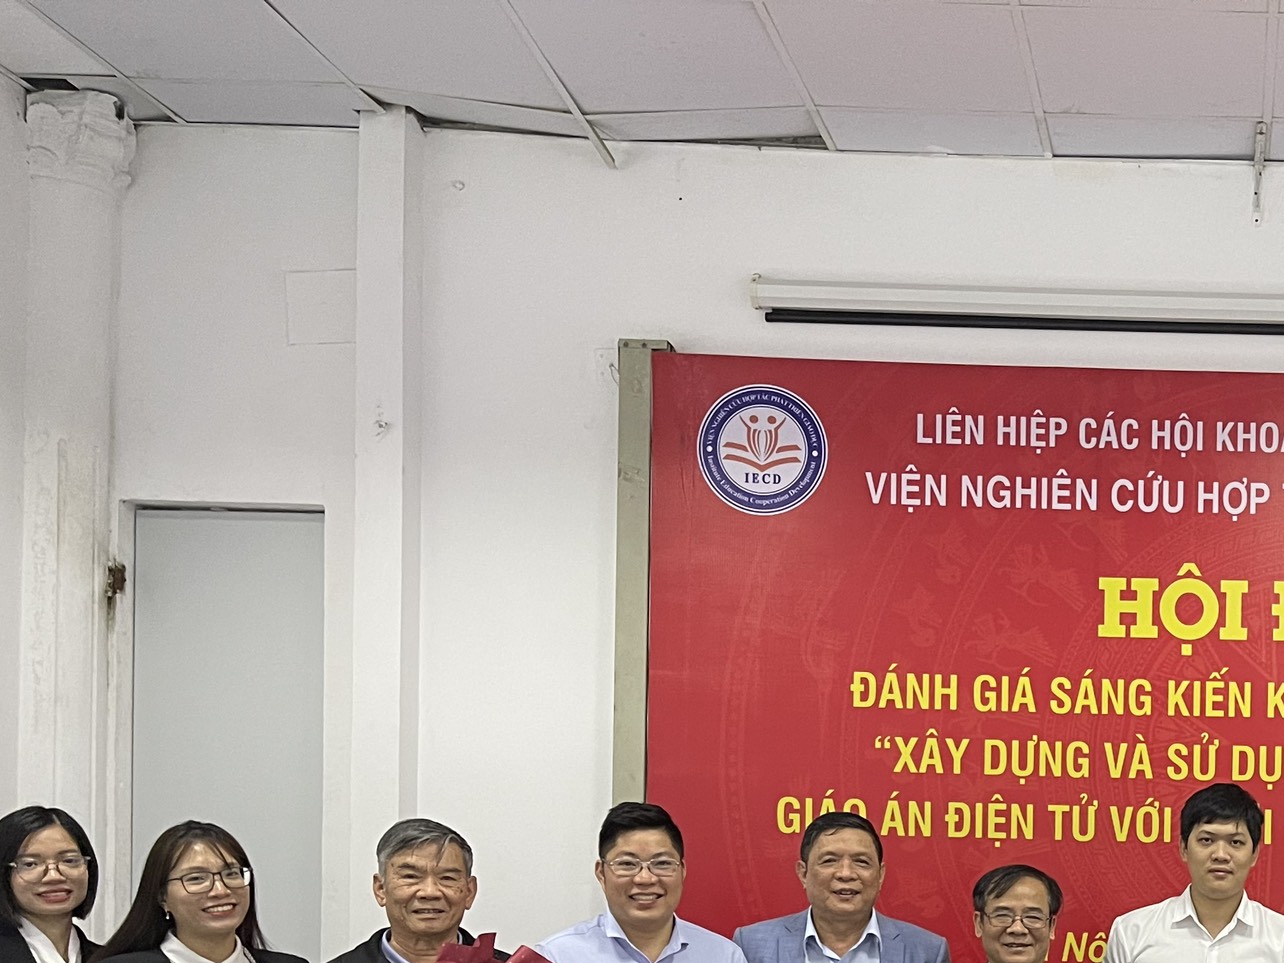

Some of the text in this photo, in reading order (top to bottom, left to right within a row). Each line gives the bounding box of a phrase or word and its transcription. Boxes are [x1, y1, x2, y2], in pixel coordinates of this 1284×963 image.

[916, 407, 984, 445] LIÊN
[997, 409, 1068, 455] HIỆP
[1079, 411, 1139, 450] CÁC
[1151, 412, 1204, 458] HỘI
[744, 472, 782, 485] IECD
[865, 465, 947, 512] VIỆN
[962, 469, 1098, 511] NGHIÊN
[1111, 470, 1184, 514] CỨU
[1197, 478, 1271, 522] HỢP
[1097, 562, 1249, 656] HỘI
[850, 662, 958, 711] ĐÁNH
[973, 667, 1037, 713] GIÁ
[1050, 669, 1152, 717] SÁNG
[1167, 667, 1252, 718] KIẾN
[874, 728, 970, 775] “XÂY
[984, 734, 1090, 785] DỰNG
[1104, 733, 1154, 780] VÀ
[1166, 732, 1221, 782] SỬ
[880, 790, 932, 838] ÁN
[945, 793, 1034, 848] ĐIỆN
[1047, 793, 1099, 842] TỬ
[1109, 797, 1172, 844] VỚI
